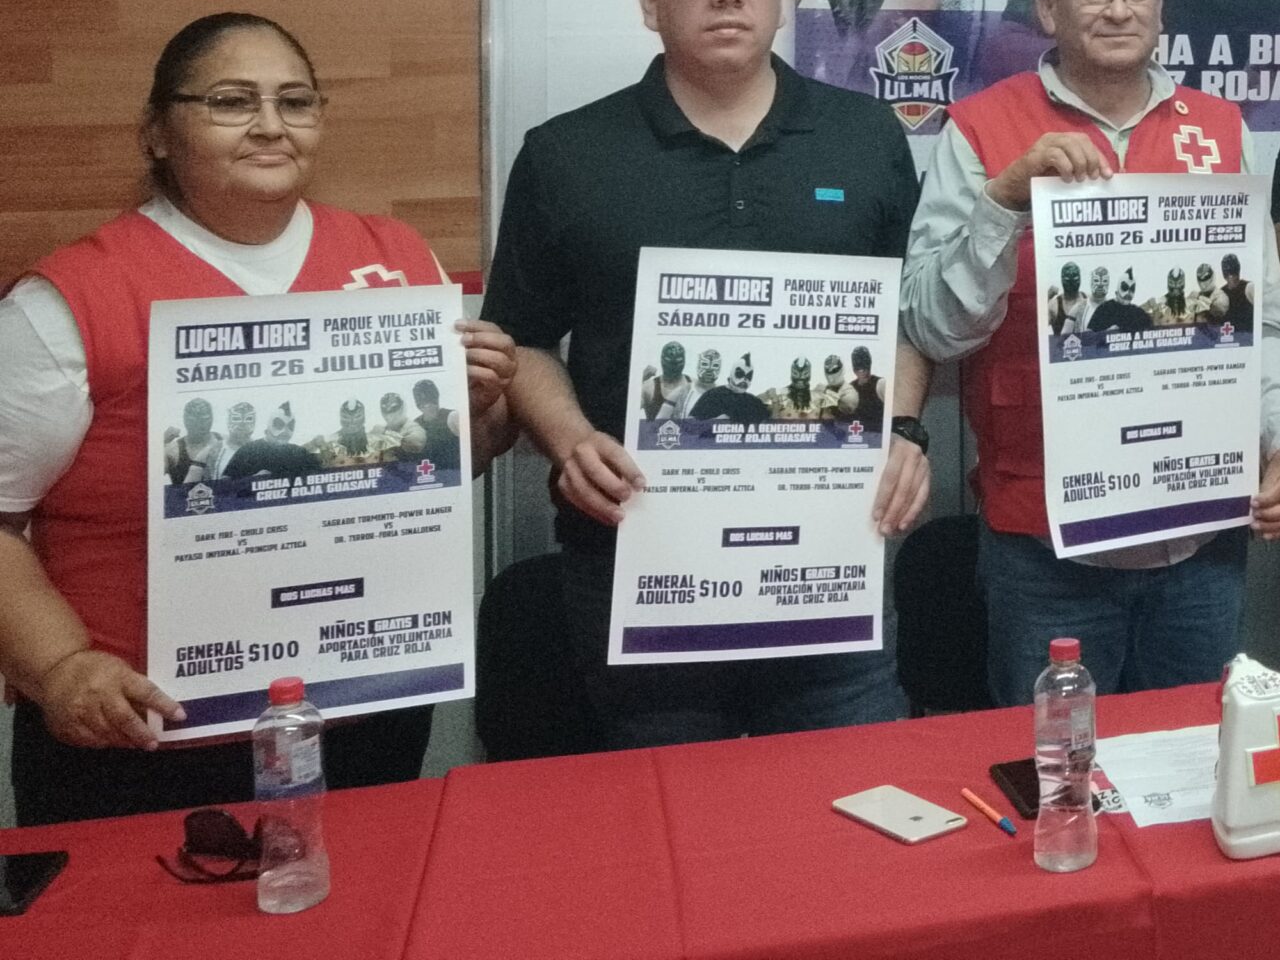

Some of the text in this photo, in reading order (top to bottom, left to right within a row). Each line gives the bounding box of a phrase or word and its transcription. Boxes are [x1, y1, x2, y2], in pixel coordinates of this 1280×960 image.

[1208, 34, 1233, 65] A
[884, 78, 945, 101] ULMA
[1158, 192, 1249, 209] PARQUE VILLAFAÑE
[1054, 199, 1147, 224] LUCHA LIBRE
[1164, 208, 1242, 222] GUASAVE SIN
[1055, 228, 1201, 249] SÁBADO 26 JULIO
[662, 277, 770, 302] LUCHA LIBRE
[784, 279, 882, 294] PARQUE VILLAFAÑE
[790, 295, 875, 308] GUASAVE SIN
[323, 309, 442, 332] PARQUE VILLAFAÑE
[658, 309, 830, 330] SÁBADO 26 JULIO
[179, 322, 307, 354] LUCHA LIBRE
[331, 327, 435, 348] GUASAVE SIN
[176, 353, 383, 383] SÁBADO 26 JULIO
[1153, 456, 1183, 474] NIÑOS
[1223, 451, 1243, 465] CON
[1063, 471, 1105, 489] GENERAL
[1108, 473, 1140, 490] $100
[1153, 466, 1243, 485] APORTACIÓN VOLUNTARIA
[1167, 476, 1228, 492] PARA CRUZ ROJA
[1064, 485, 1106, 503] ADULTOS
[638, 575, 696, 590] GENERAL
[760, 565, 798, 583] NIÑOS
[844, 565, 866, 578] CON
[636, 590, 695, 604] ADULTOS
[700, 580, 742, 598] $100
[759, 581, 866, 596] APORTACIÓN VOLUNTARIA
[776, 593, 849, 606] PARA CRUZ ROJA
[319, 620, 365, 640] NIÑOS
[423, 610, 452, 627] CON
[176, 640, 243, 662] GENERAL
[319, 628, 452, 654] APORTACIÓN VOLUNTARIA
[249, 641, 299, 662] $100
[341, 642, 431, 662] PARA CRUZ ROJA
[176, 658, 244, 678] ADULTOS
